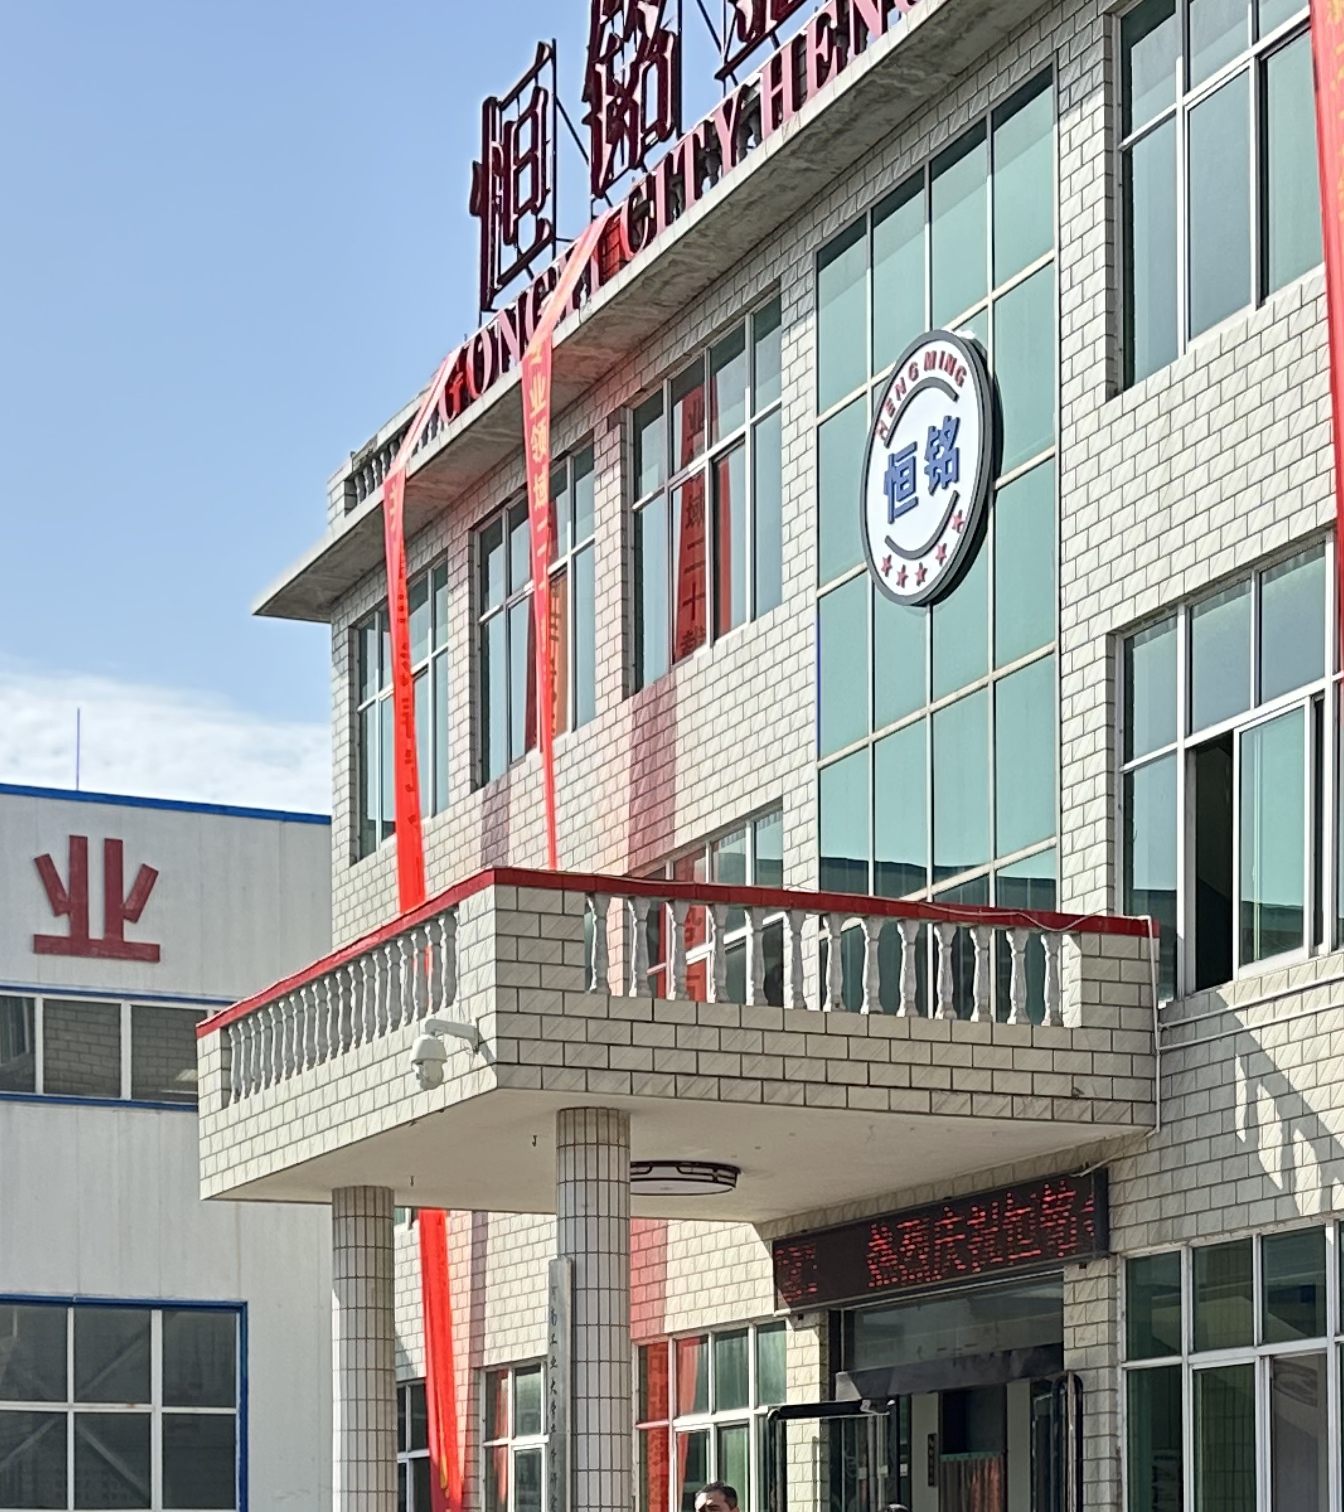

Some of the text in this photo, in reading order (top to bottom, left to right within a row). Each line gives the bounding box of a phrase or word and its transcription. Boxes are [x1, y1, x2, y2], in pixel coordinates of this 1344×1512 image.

[621, 84, 747, 262] CITY
[758, 0, 921, 140] HEN
[883, 415, 961, 525] 恒铭
